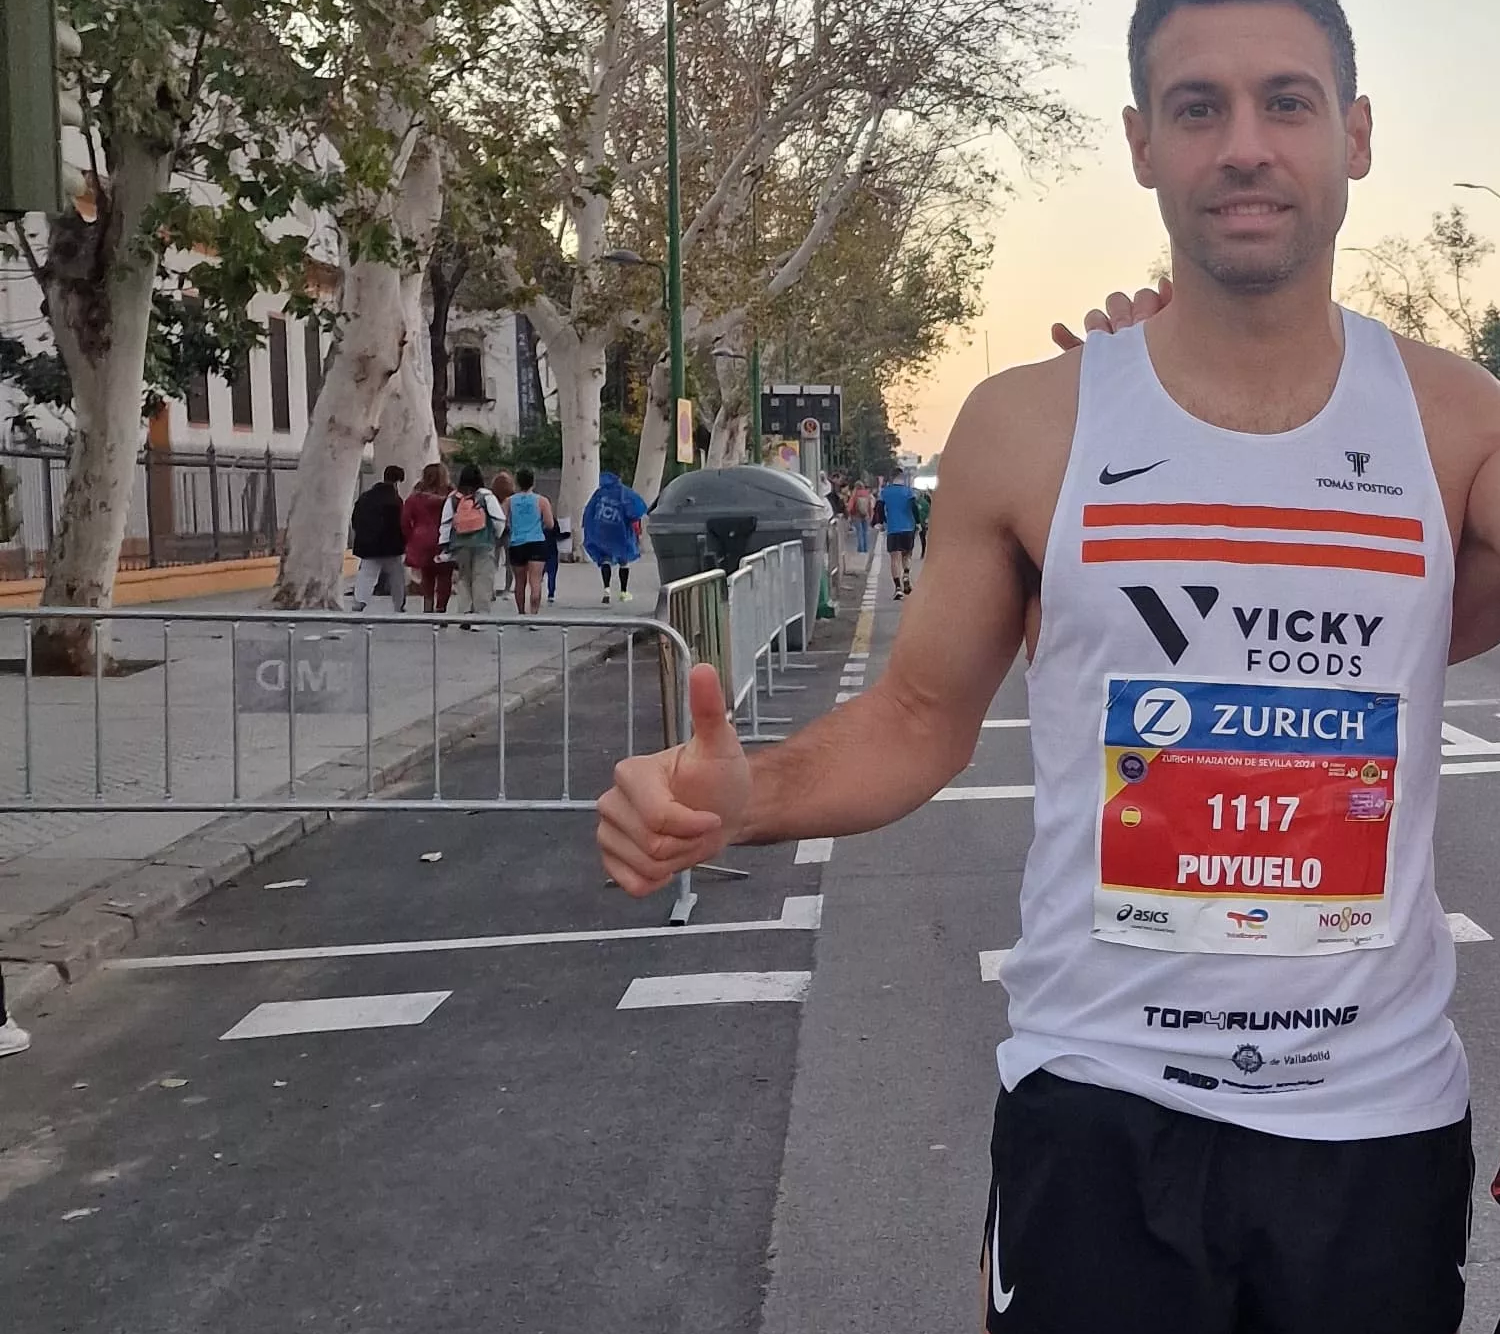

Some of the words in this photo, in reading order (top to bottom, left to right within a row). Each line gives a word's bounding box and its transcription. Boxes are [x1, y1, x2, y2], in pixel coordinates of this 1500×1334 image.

[1357, 482, 1404, 496] POSTIGO
[1232, 607, 1384, 647] VICKY
[1247, 649, 1363, 678] FOODS
[1211, 703, 1365, 741] ZURICH
[1162, 754, 1194, 764] ZURICH
[1196, 754, 1243, 767] MARATÓN
[1244, 757, 1257, 767] DE
[1258, 759, 1292, 768] SEVILLA
[1206, 792, 1300, 833] 1117
[1177, 854, 1322, 889] PUYUELO
[1133, 909, 1169, 924] asics
[1143, 1005, 1360, 1031] TOP4RUNNING
[1283, 1050, 1331, 1065] Valladolid
